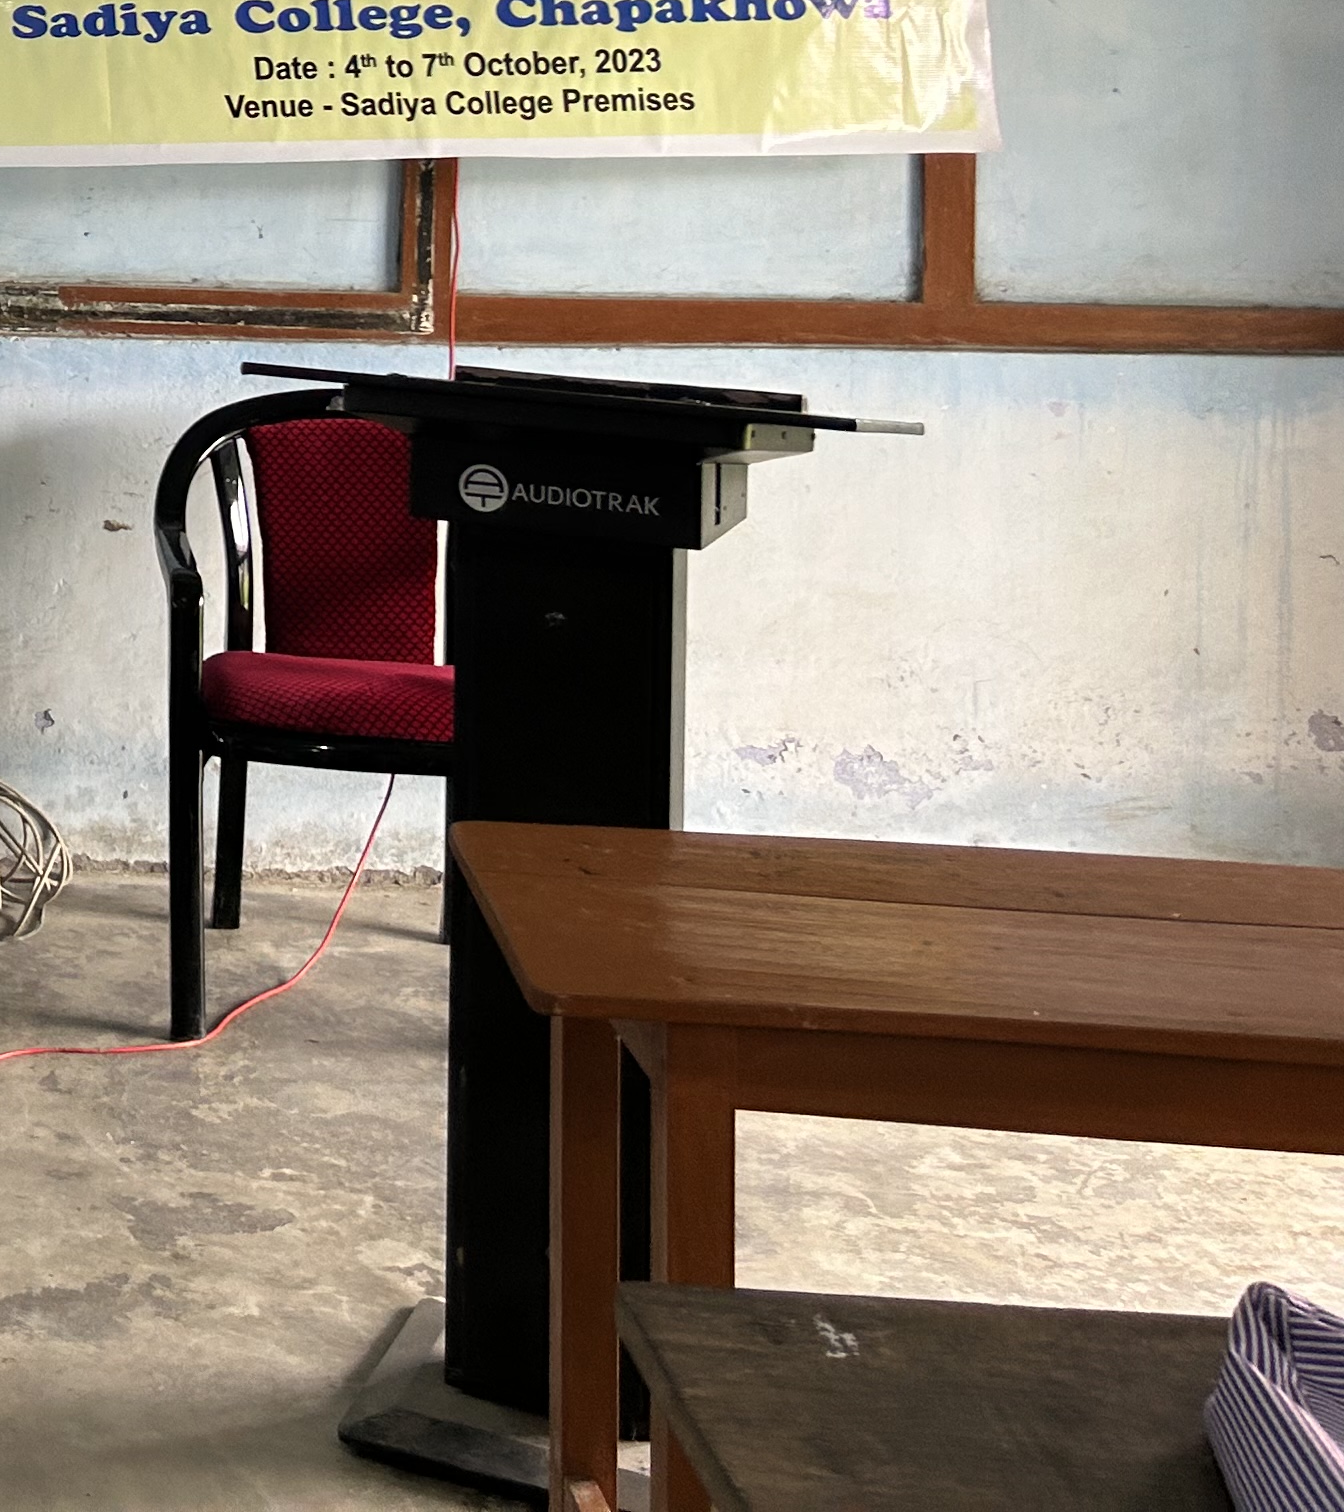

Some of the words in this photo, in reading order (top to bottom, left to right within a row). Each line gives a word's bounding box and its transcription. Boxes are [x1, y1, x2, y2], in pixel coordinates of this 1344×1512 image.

[11, 0, 211, 43] Sadiya
[253, 55, 318, 81] Date
[344, 53, 377, 78] 4th
[386, 55, 413, 78] to
[422, 51, 455, 77] 7th
[464, 49, 586, 78] October,
[595, 47, 662, 75] 2023
[224, 94, 313, 119] Venue
[340, 92, 437, 121] Sadiya
[446, 91, 553, 120] College
[563, 87, 696, 114] Premises
[511, 483, 660, 516] AUDIOTRAK
